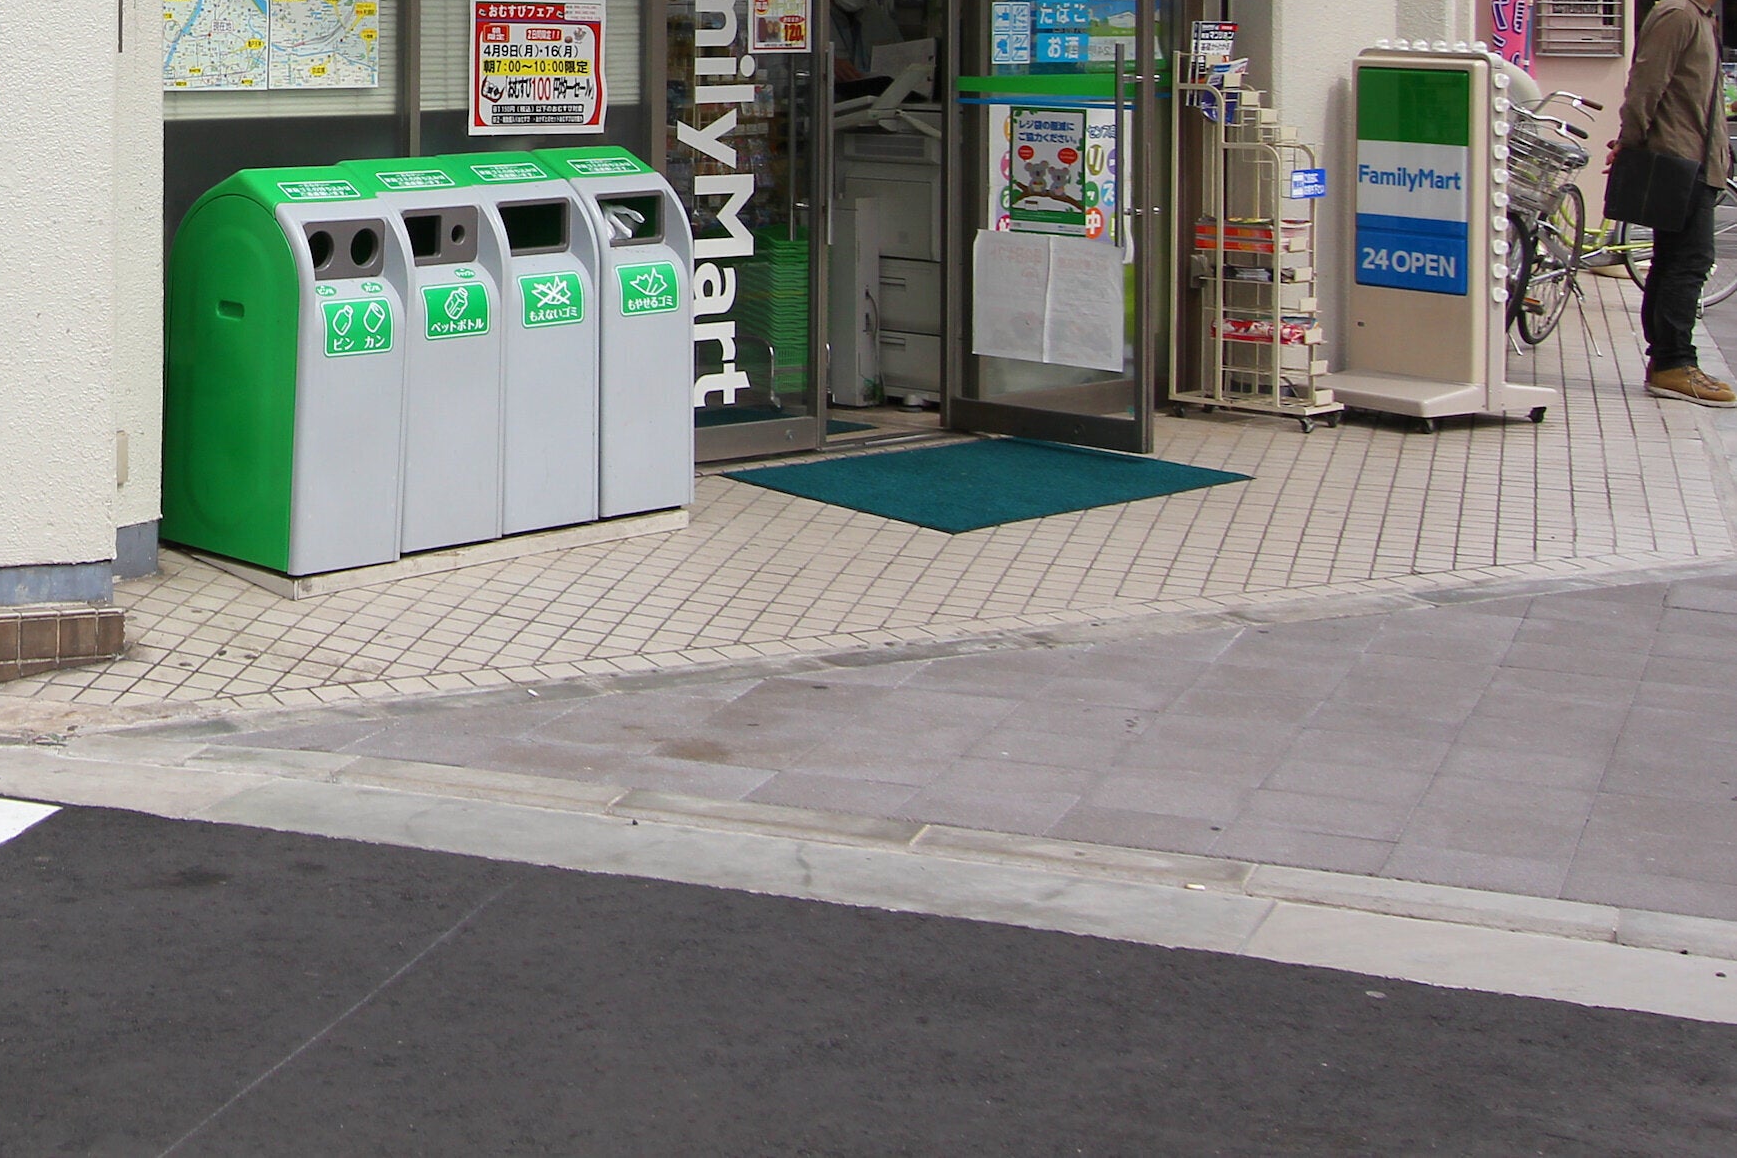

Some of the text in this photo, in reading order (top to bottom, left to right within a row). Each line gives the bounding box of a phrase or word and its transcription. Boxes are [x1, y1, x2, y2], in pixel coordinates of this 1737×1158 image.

[488, 5, 555, 18] おむすびフェア
[1358, 164, 1462, 193] FamilyMart
[1362, 247, 1456, 279] 24 OPEN
[627, 293, 675, 312] もやせるゴミ
[528, 304, 579, 324] もえないゴミ
[431, 319, 485, 333] ペットボトル
[364, 335, 386, 349] カン
